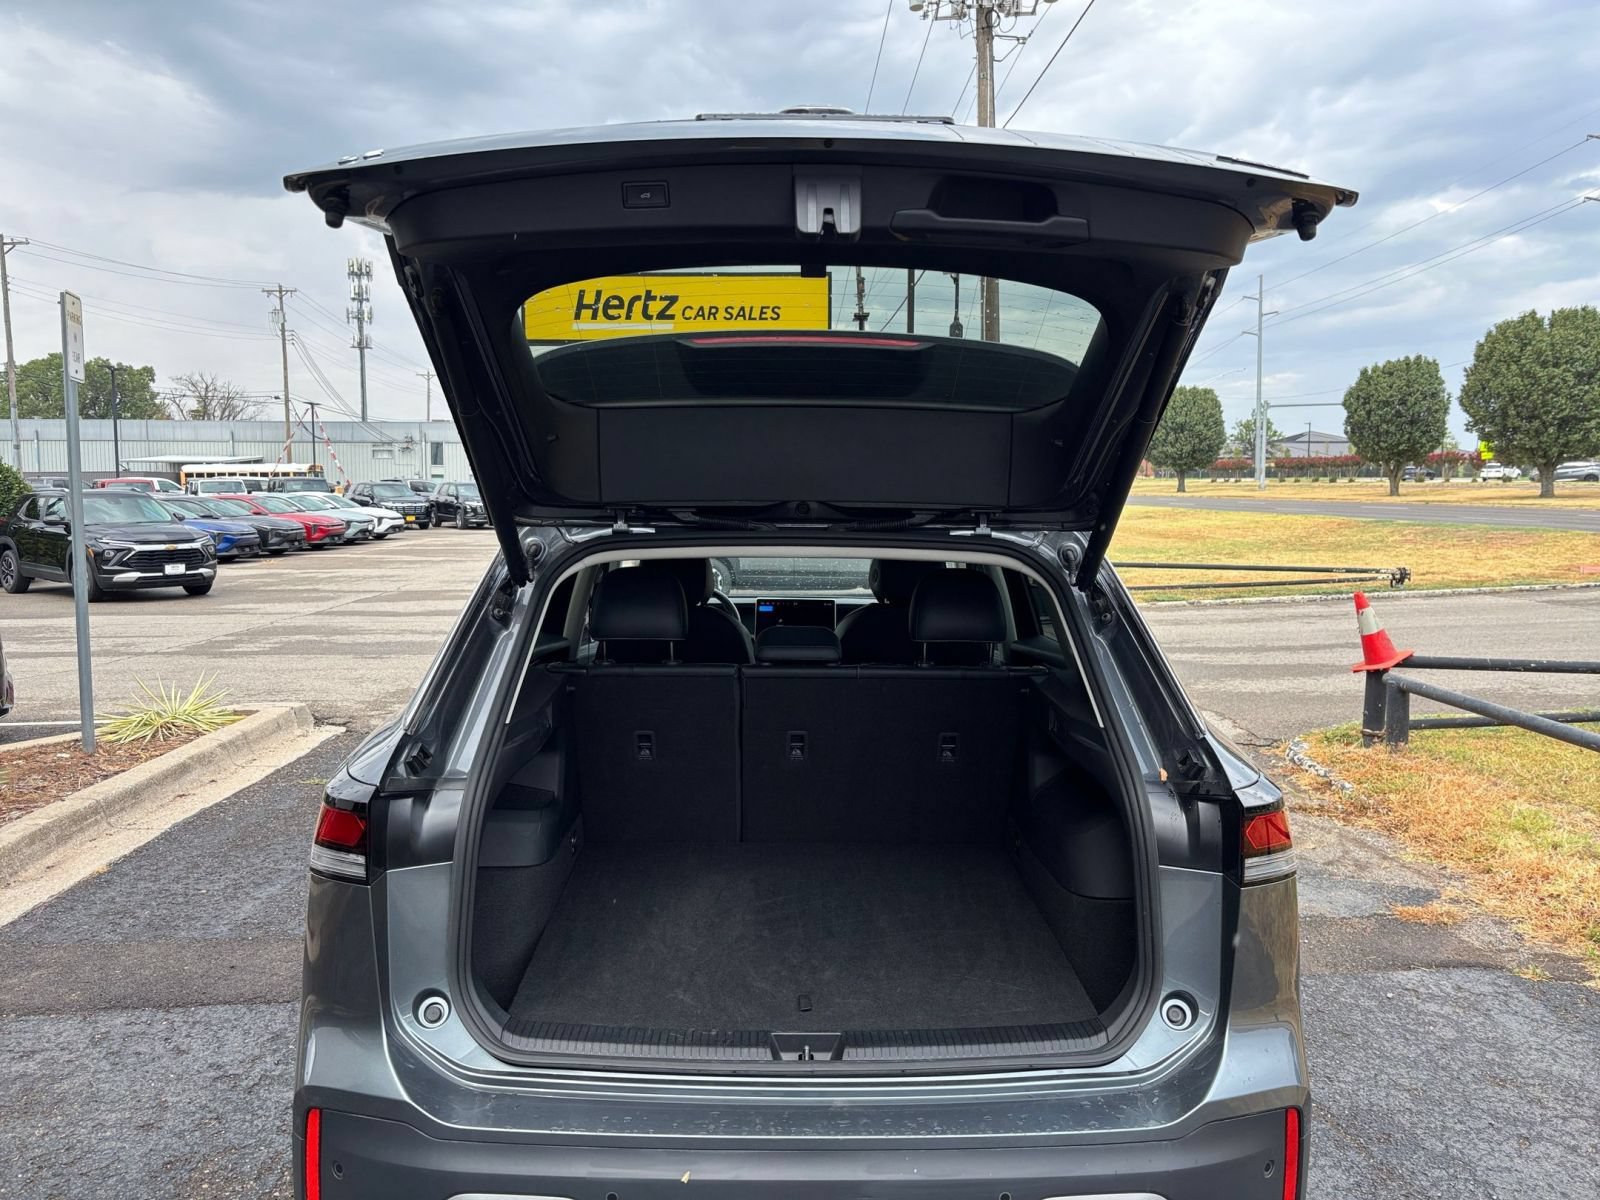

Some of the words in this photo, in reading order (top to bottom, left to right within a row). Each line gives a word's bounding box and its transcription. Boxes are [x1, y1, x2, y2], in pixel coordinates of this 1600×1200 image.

[574, 289, 680, 321] Hertz
[681, 305, 720, 321] CAR
[723, 305, 782, 321] SALES
